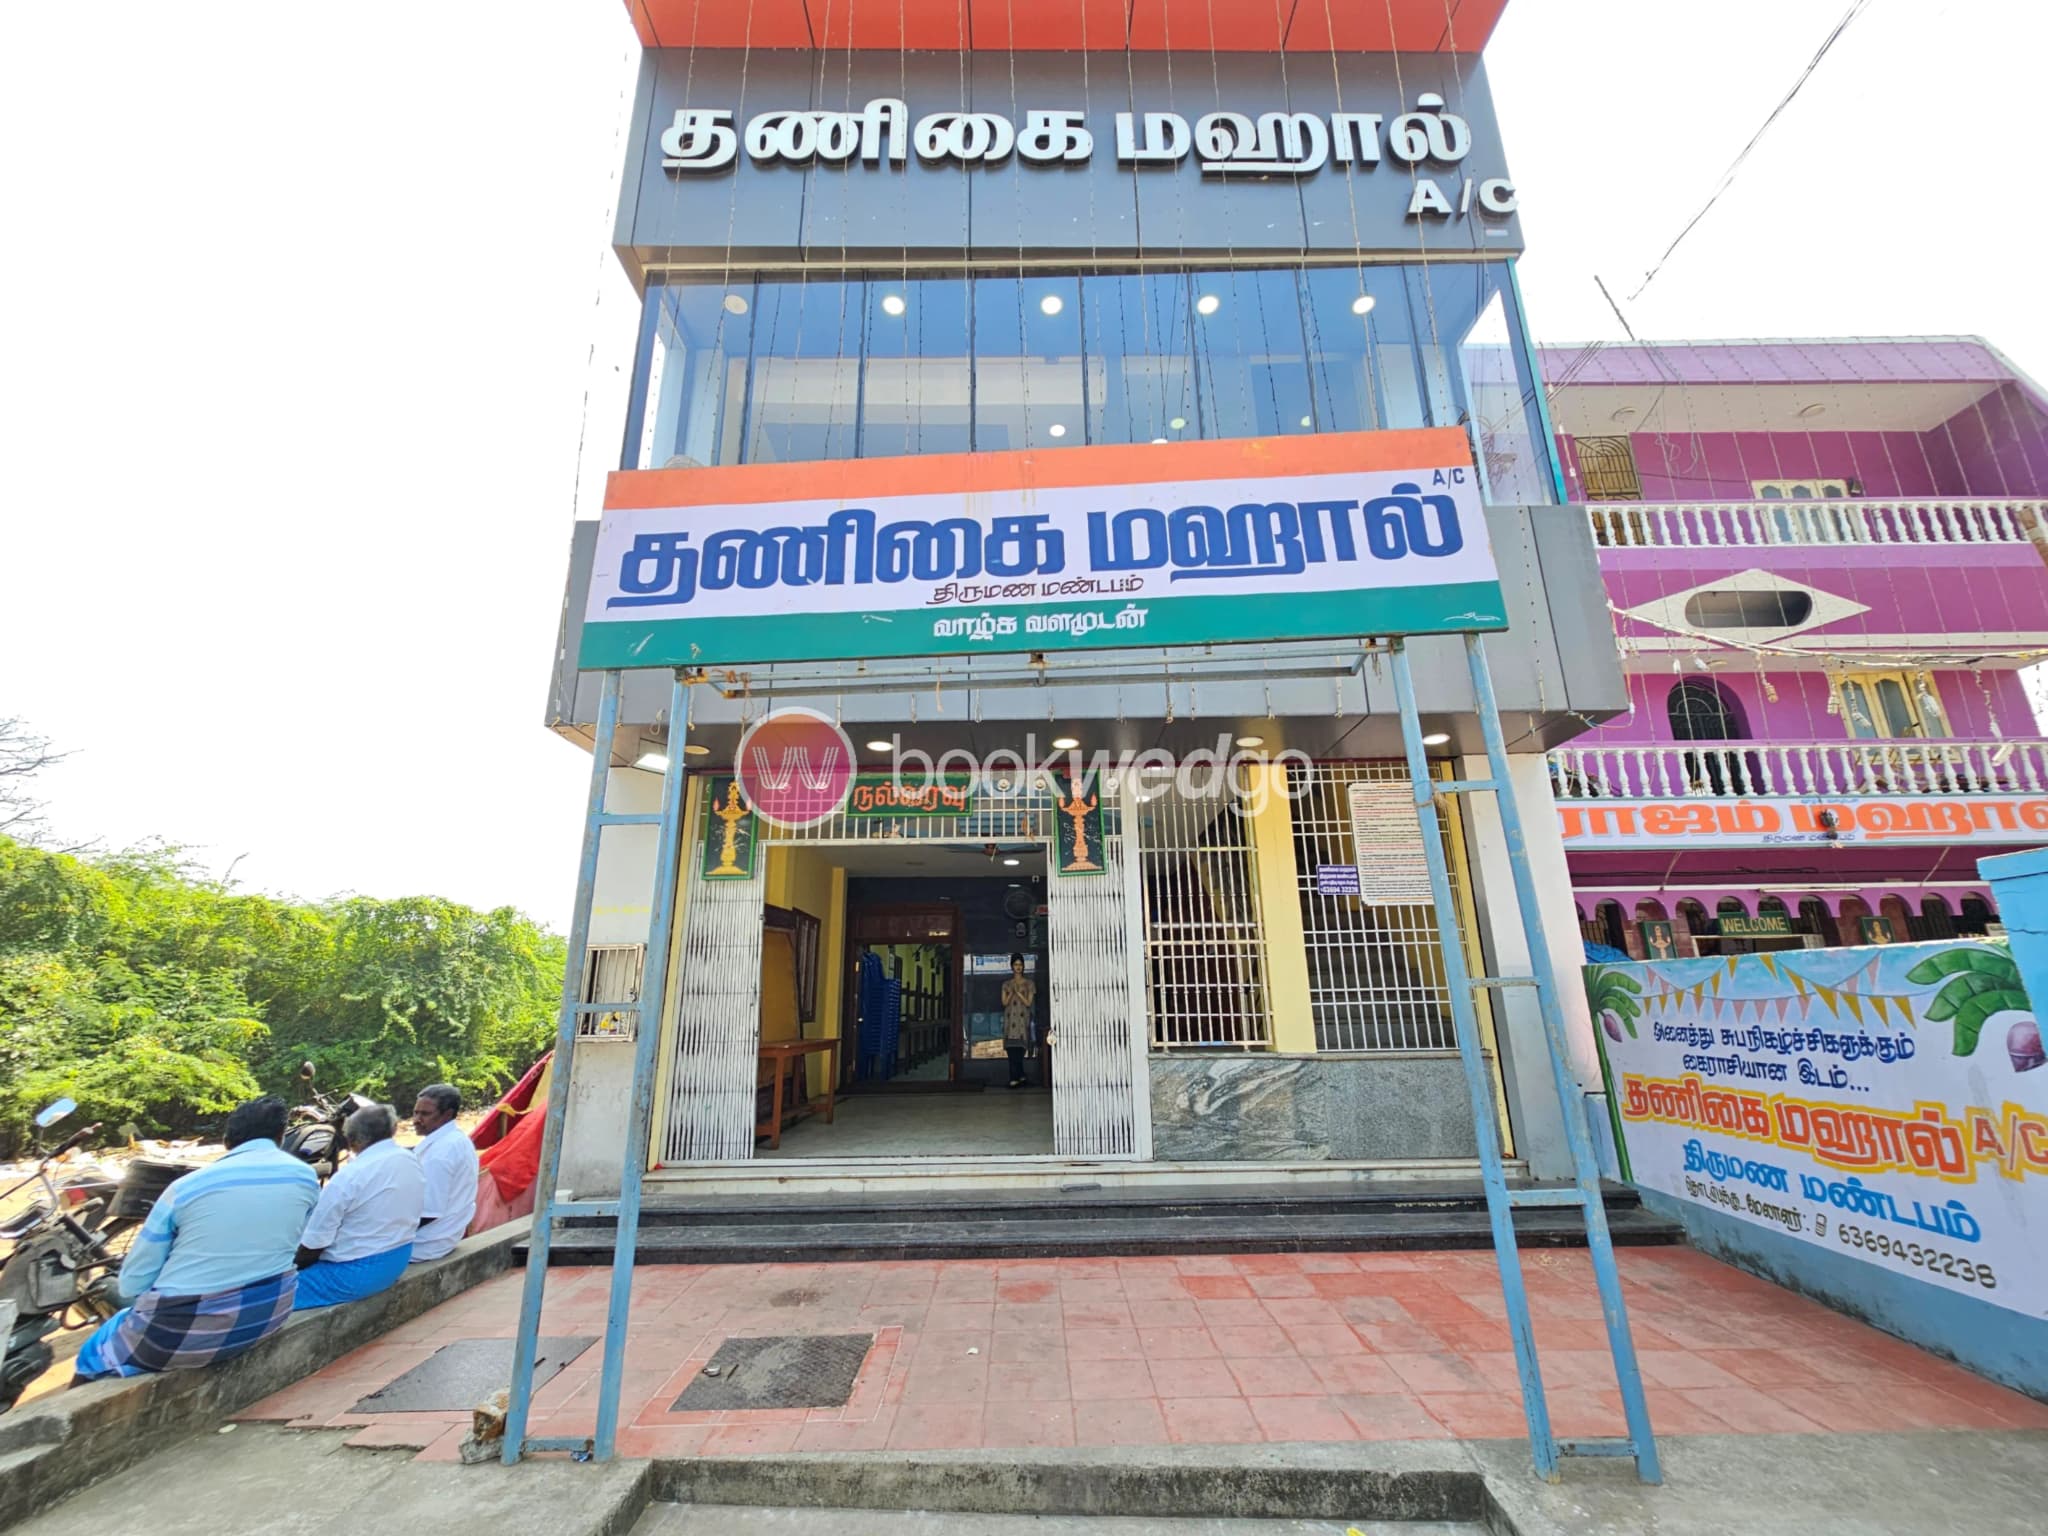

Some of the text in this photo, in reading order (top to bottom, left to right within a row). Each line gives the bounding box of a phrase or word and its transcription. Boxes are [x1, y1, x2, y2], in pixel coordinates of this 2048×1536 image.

[662, 93, 1473, 174] தணிகை மஹால்
[1405, 178, 1519, 215] A/C
[1432, 467, 1465, 490] A/C
[605, 482, 1464, 608] தணிகை மஹால்
[926, 574, 1144, 604] திருமண மண்டபம்
[933, 602, 1149, 641] வாழ்க வளமுடன்
[852, 780, 967, 812] நல்வரவு
[1721, 916, 1788, 933] WELCOME
[1653, 1020, 1715, 1050] அனைத்து
[1682, 1053, 1788, 1082] கைராசியான
[1624, 1076, 2048, 1175] தணிகை மஹால் A/C
[1682, 1139, 1981, 1243] திருமண மண்டபம்
[1837, 1222, 1998, 1290] 6369432238
